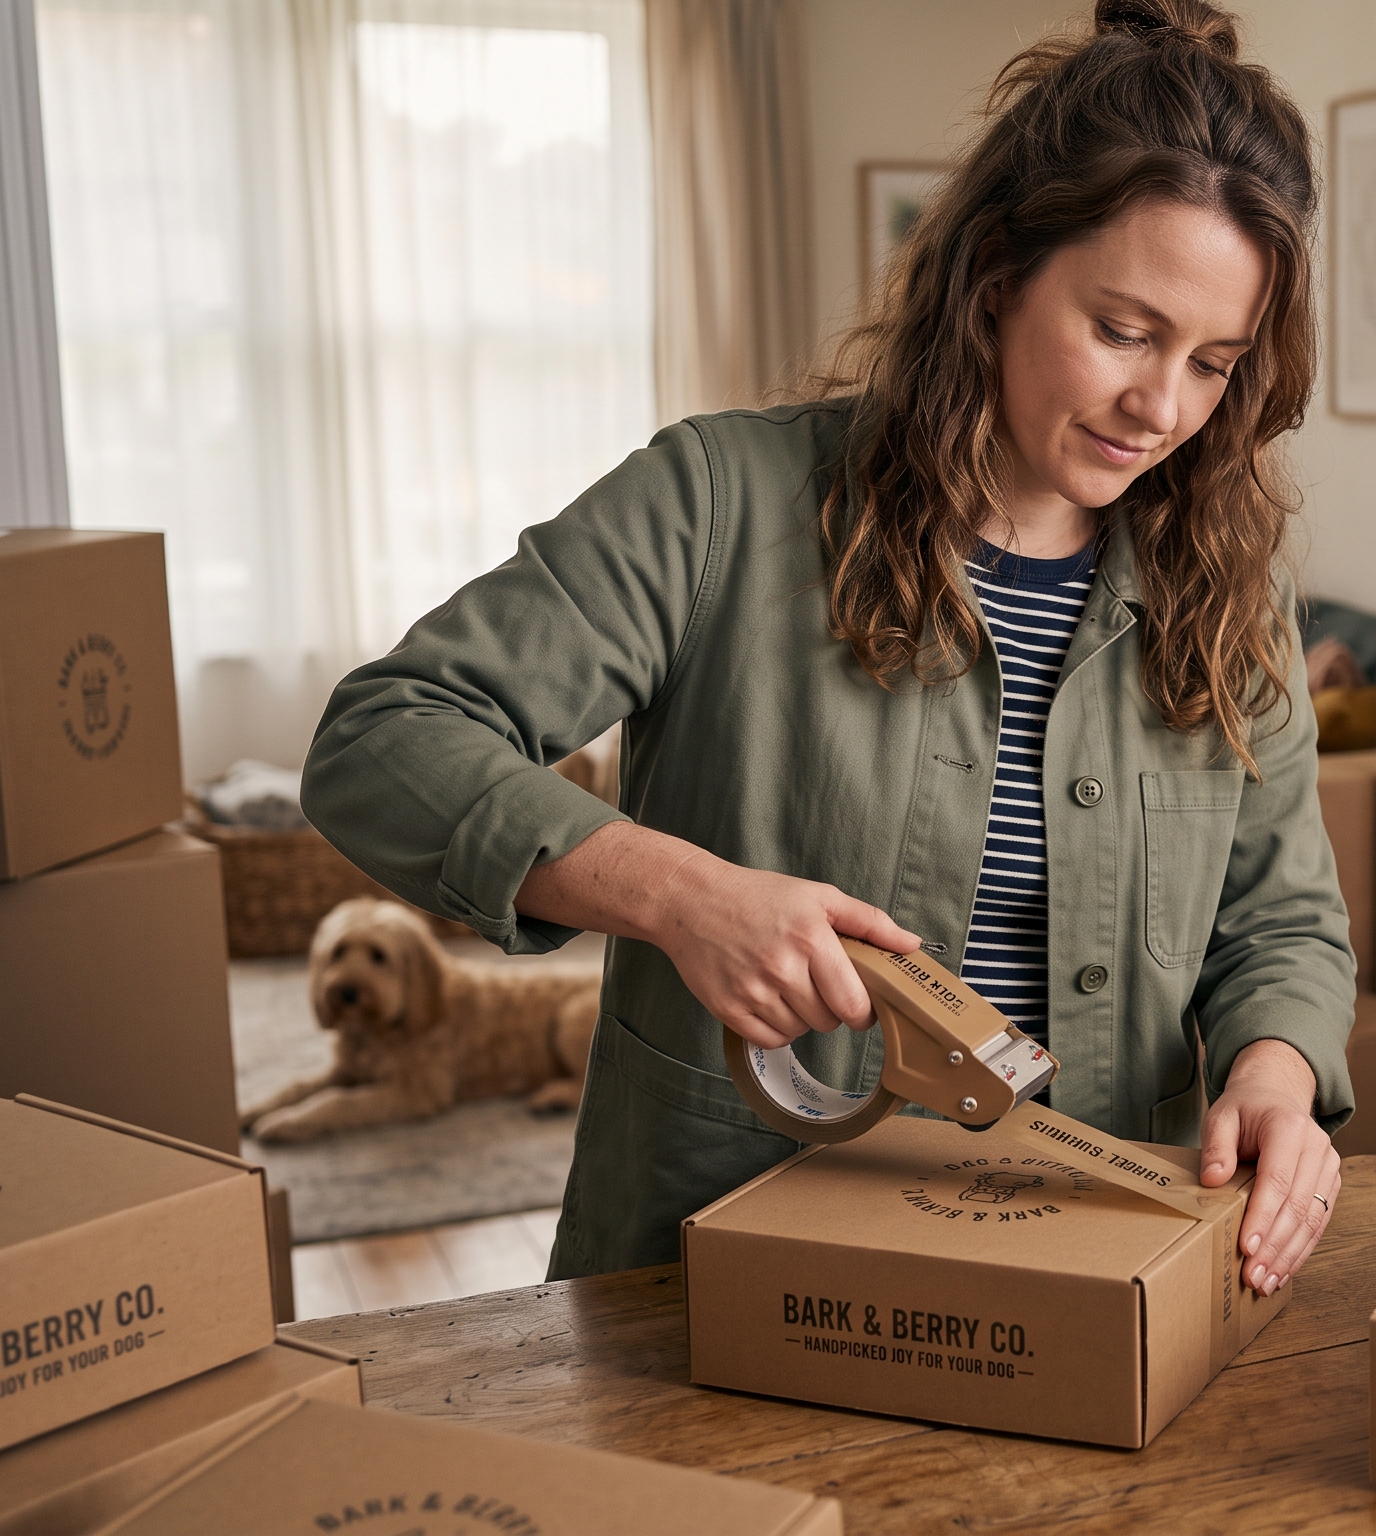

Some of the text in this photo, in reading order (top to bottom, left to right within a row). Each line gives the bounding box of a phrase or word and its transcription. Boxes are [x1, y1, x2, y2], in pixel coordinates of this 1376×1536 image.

[972, 1212, 988, 1222] &
[998, 1204, 1062, 1222] BARK
[1, 1284, 164, 1367] BERRY CO.
[783, 1293, 1034, 1357] BARK & BERRY CO.
[32, 1360, 64, 1386] FOR
[68, 1344, 110, 1373] YOUR
[114, 1331, 145, 1357] DOG
[804, 1335, 1015, 1379] HANDPICKED JOY FOR YOUR DOG
